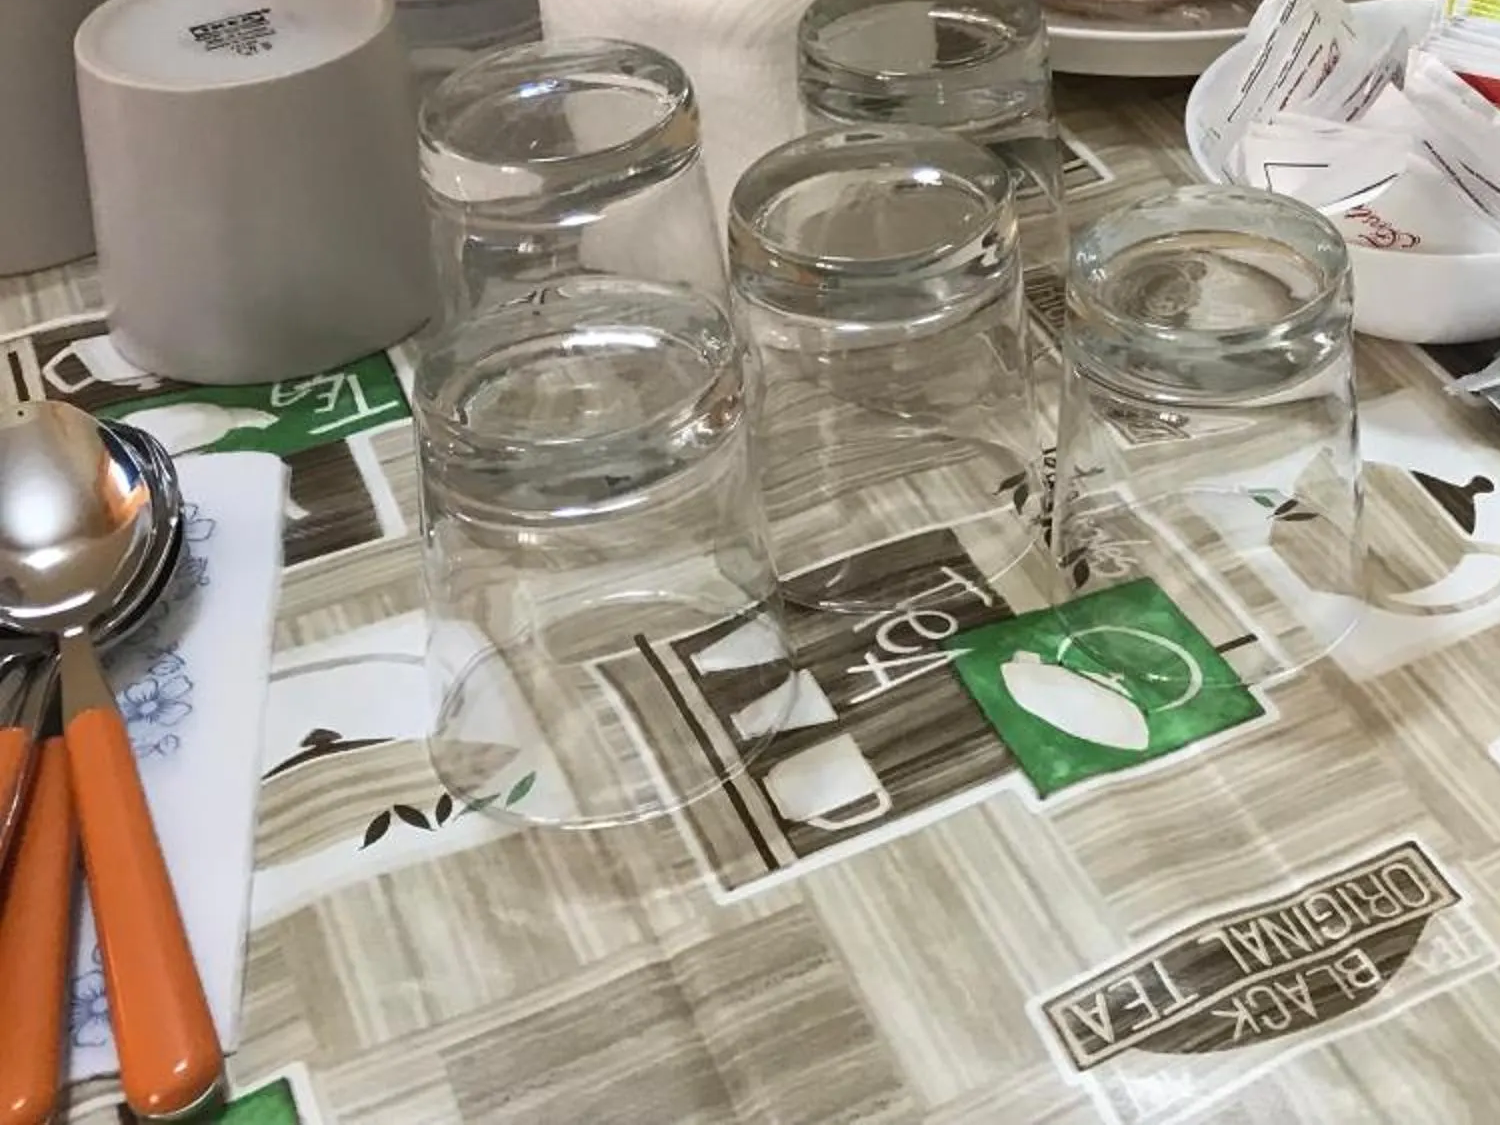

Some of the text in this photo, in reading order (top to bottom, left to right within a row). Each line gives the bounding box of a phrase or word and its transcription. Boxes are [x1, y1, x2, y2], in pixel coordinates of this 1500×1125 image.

[1073, 861, 1433, 1044] ORIGINAL TEA
[1211, 947, 1383, 1041] BLACK
